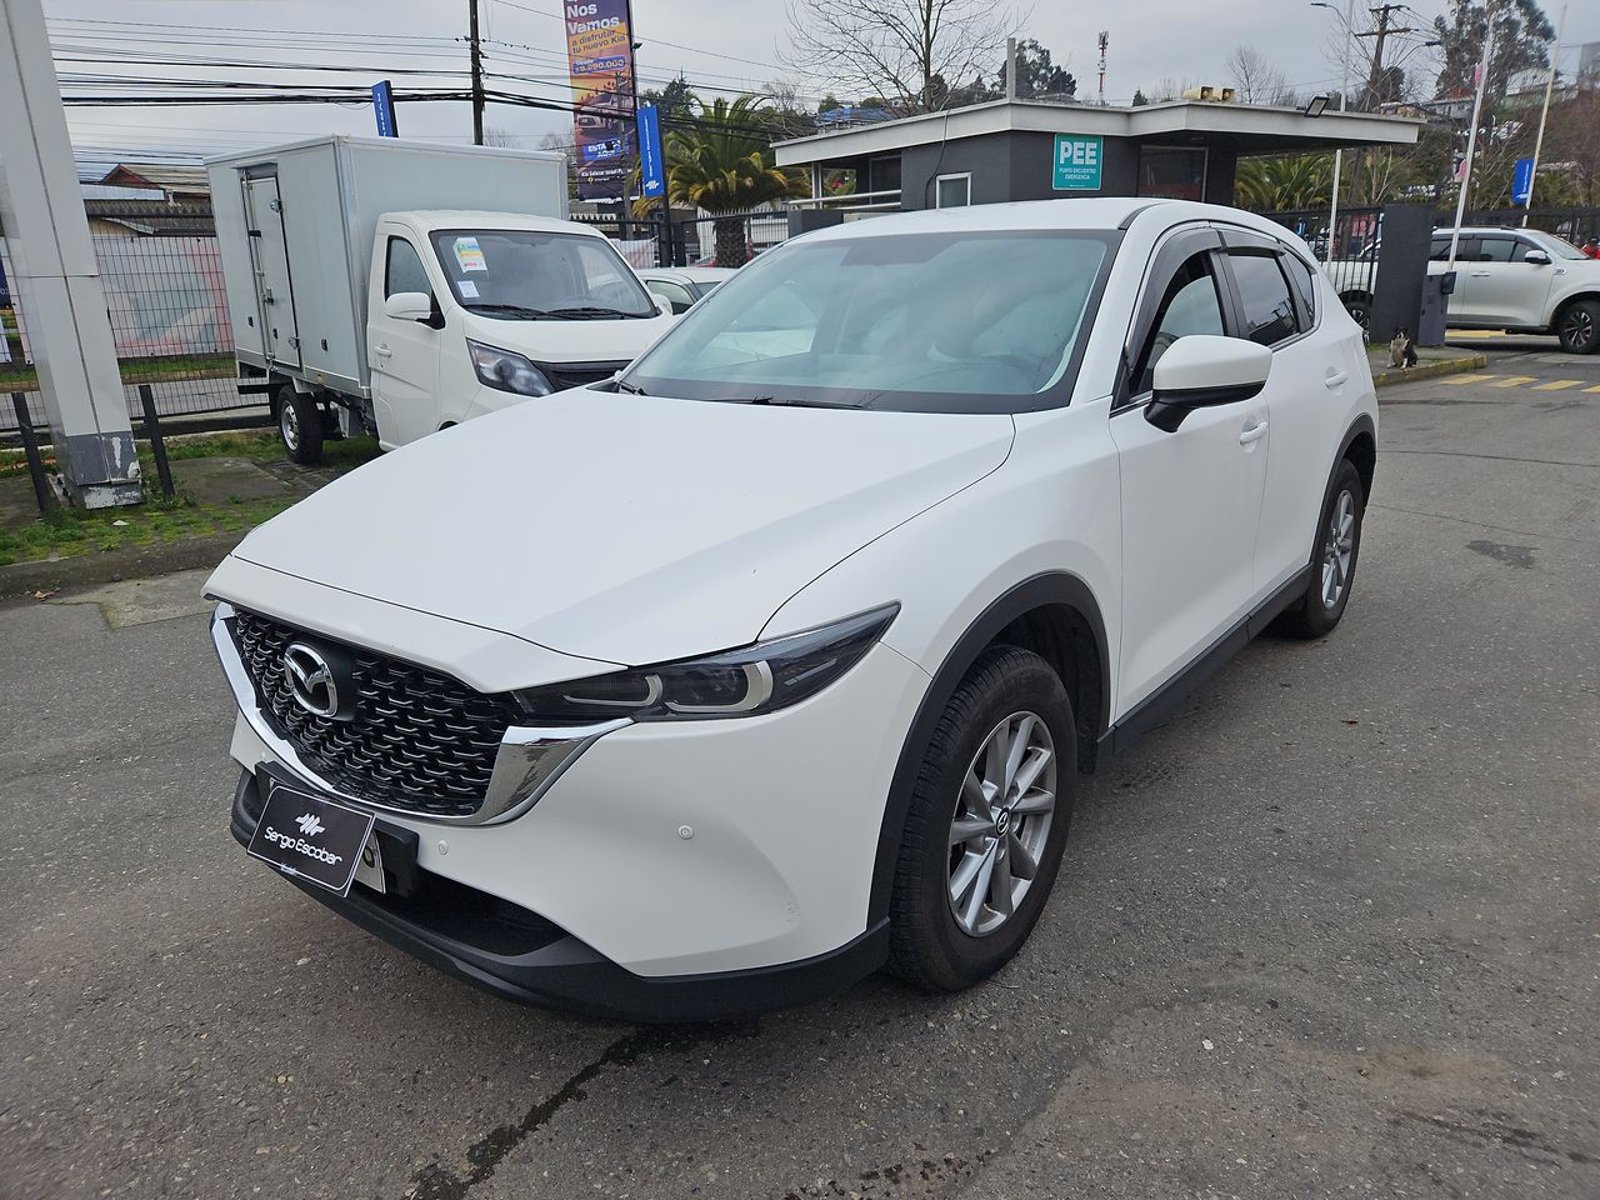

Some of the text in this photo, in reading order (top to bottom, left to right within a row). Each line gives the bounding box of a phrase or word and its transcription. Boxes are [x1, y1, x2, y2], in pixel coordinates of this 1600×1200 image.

[567, 4, 598, 19] Nos
[568, 16, 620, 35] Vamos
[580, 29, 615, 44] disfrutar
[583, 40, 609, 51] nuevo
[611, 35, 626, 44] Kia
[1059, 140, 1098, 165] PEE
[295, 838, 343, 865] Escobar
